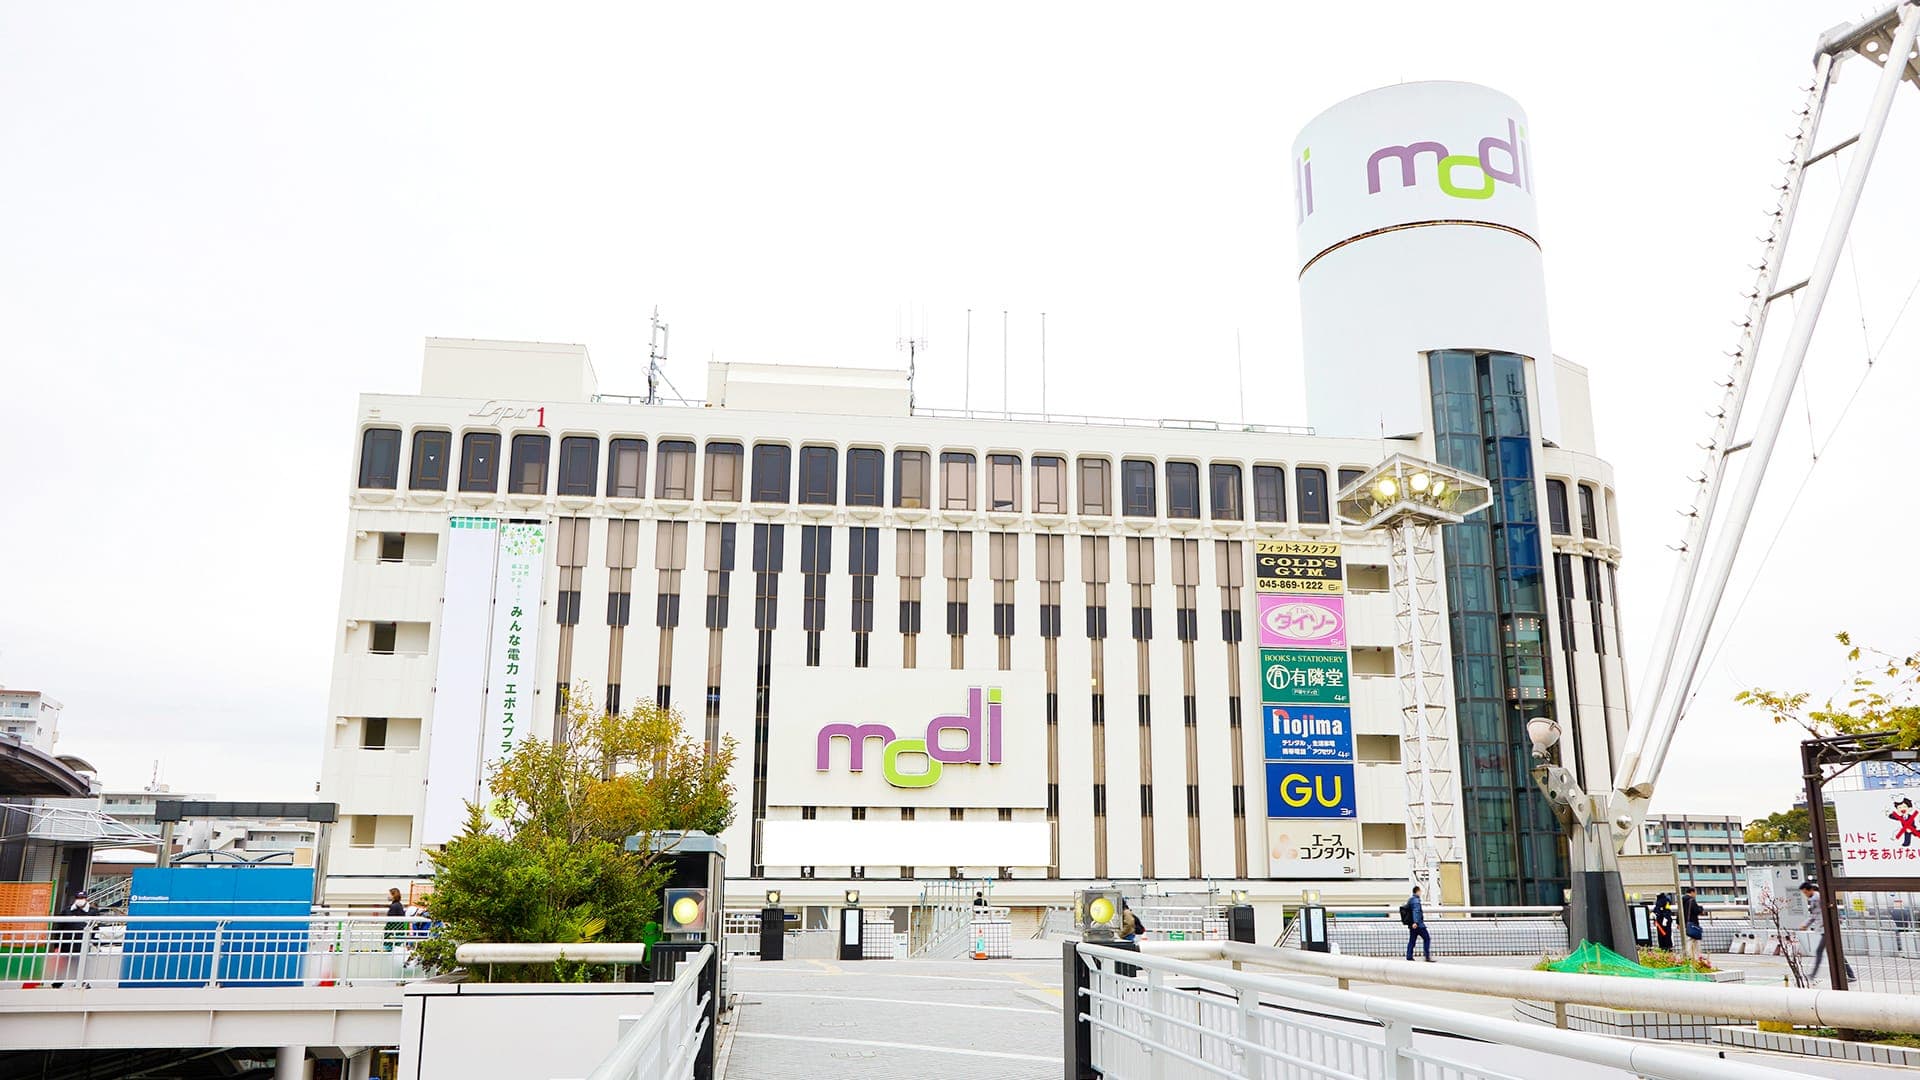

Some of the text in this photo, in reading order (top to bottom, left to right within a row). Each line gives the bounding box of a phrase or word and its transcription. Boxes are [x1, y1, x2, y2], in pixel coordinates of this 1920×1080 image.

[537, 407, 546, 428] 1
[1258, 543, 1337, 554] フィットネスクラブ
[1260, 557, 1338, 568] GOLD'S
[1259, 579, 1323, 590] 045-869-1222
[1274, 611, 1335, 630] ダイソー
[506, 606, 523, 675] みんな電力
[1264, 654, 1290, 662] BOOKS
[1298, 655, 1344, 663] STATIONERY
[1290, 667, 1344, 687] 有隣堂
[816, 686, 1002, 788] modi
[1280, 773, 1342, 808] GU
[1312, 834, 1343, 847] エース
[1844, 831, 1878, 843] ハトに
[1300, 847, 1355, 860] コンタクト
